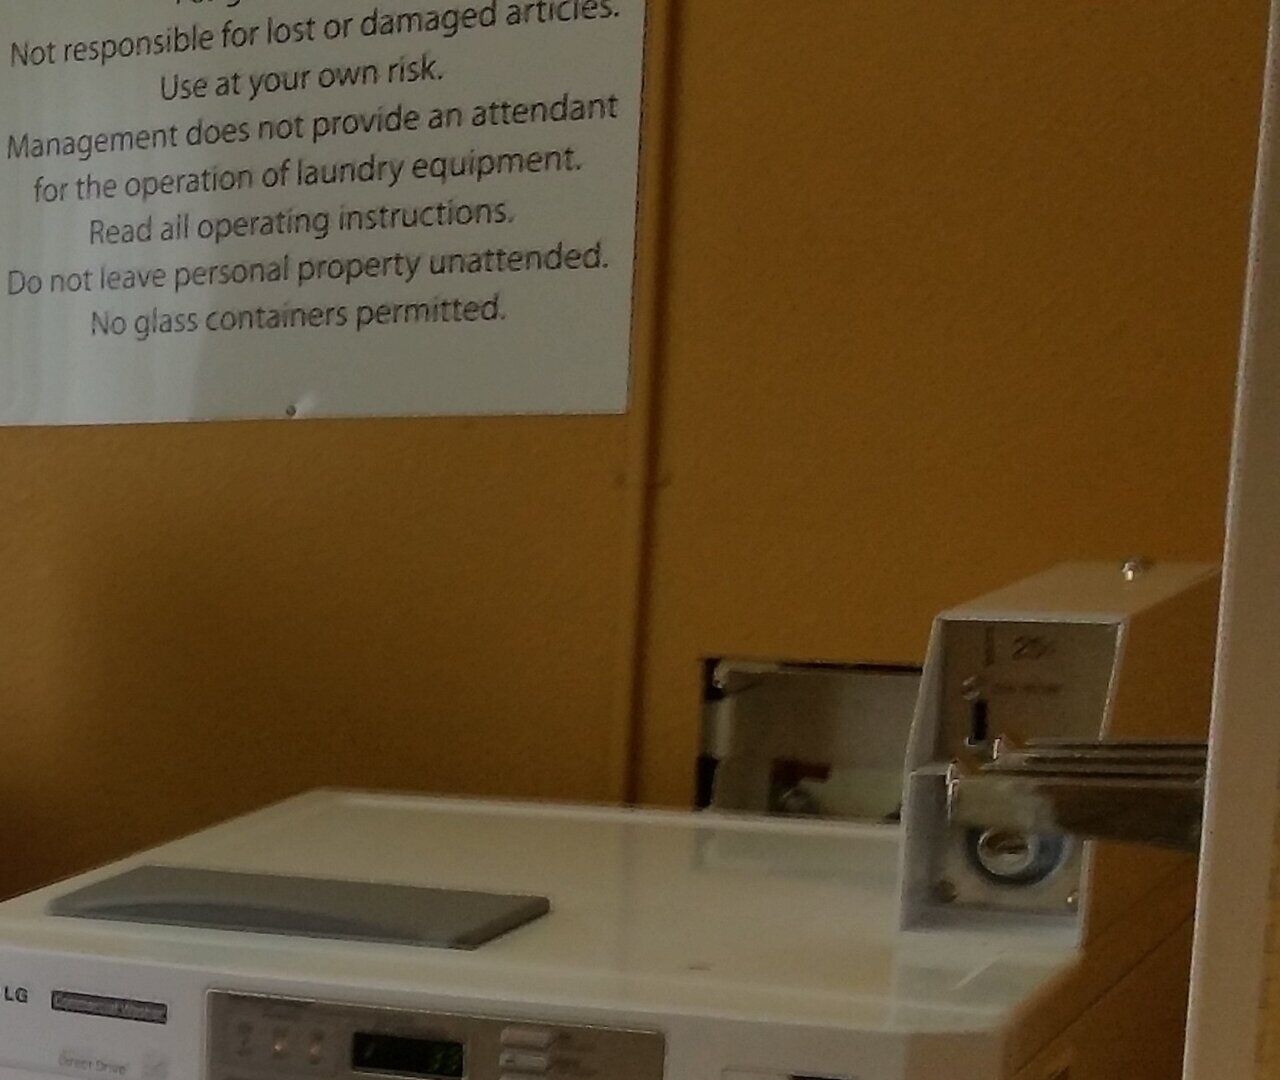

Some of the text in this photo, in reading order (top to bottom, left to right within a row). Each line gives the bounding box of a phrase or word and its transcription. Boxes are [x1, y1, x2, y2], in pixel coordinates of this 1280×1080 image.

[10, 40, 56, 67] Not
[64, 24, 214, 65] responsible
[222, 19, 259, 48] for
[267, 16, 316, 44] lost
[323, 16, 353, 40] or
[360, 1, 496, 38] damaged
[160, 52, 443, 101] Use at your own risk.
[6, 92, 619, 161] Management does not provide an attendant
[34, 146, 582, 203] for the operation of laundry equipment.
[90, 199, 515, 245] Read all operating instructions.
[7, 240, 609, 296] Do not leave personal property unattended.
[91, 292, 507, 342] No glass containers permitted.
[4, 984, 28, 1004] LG
